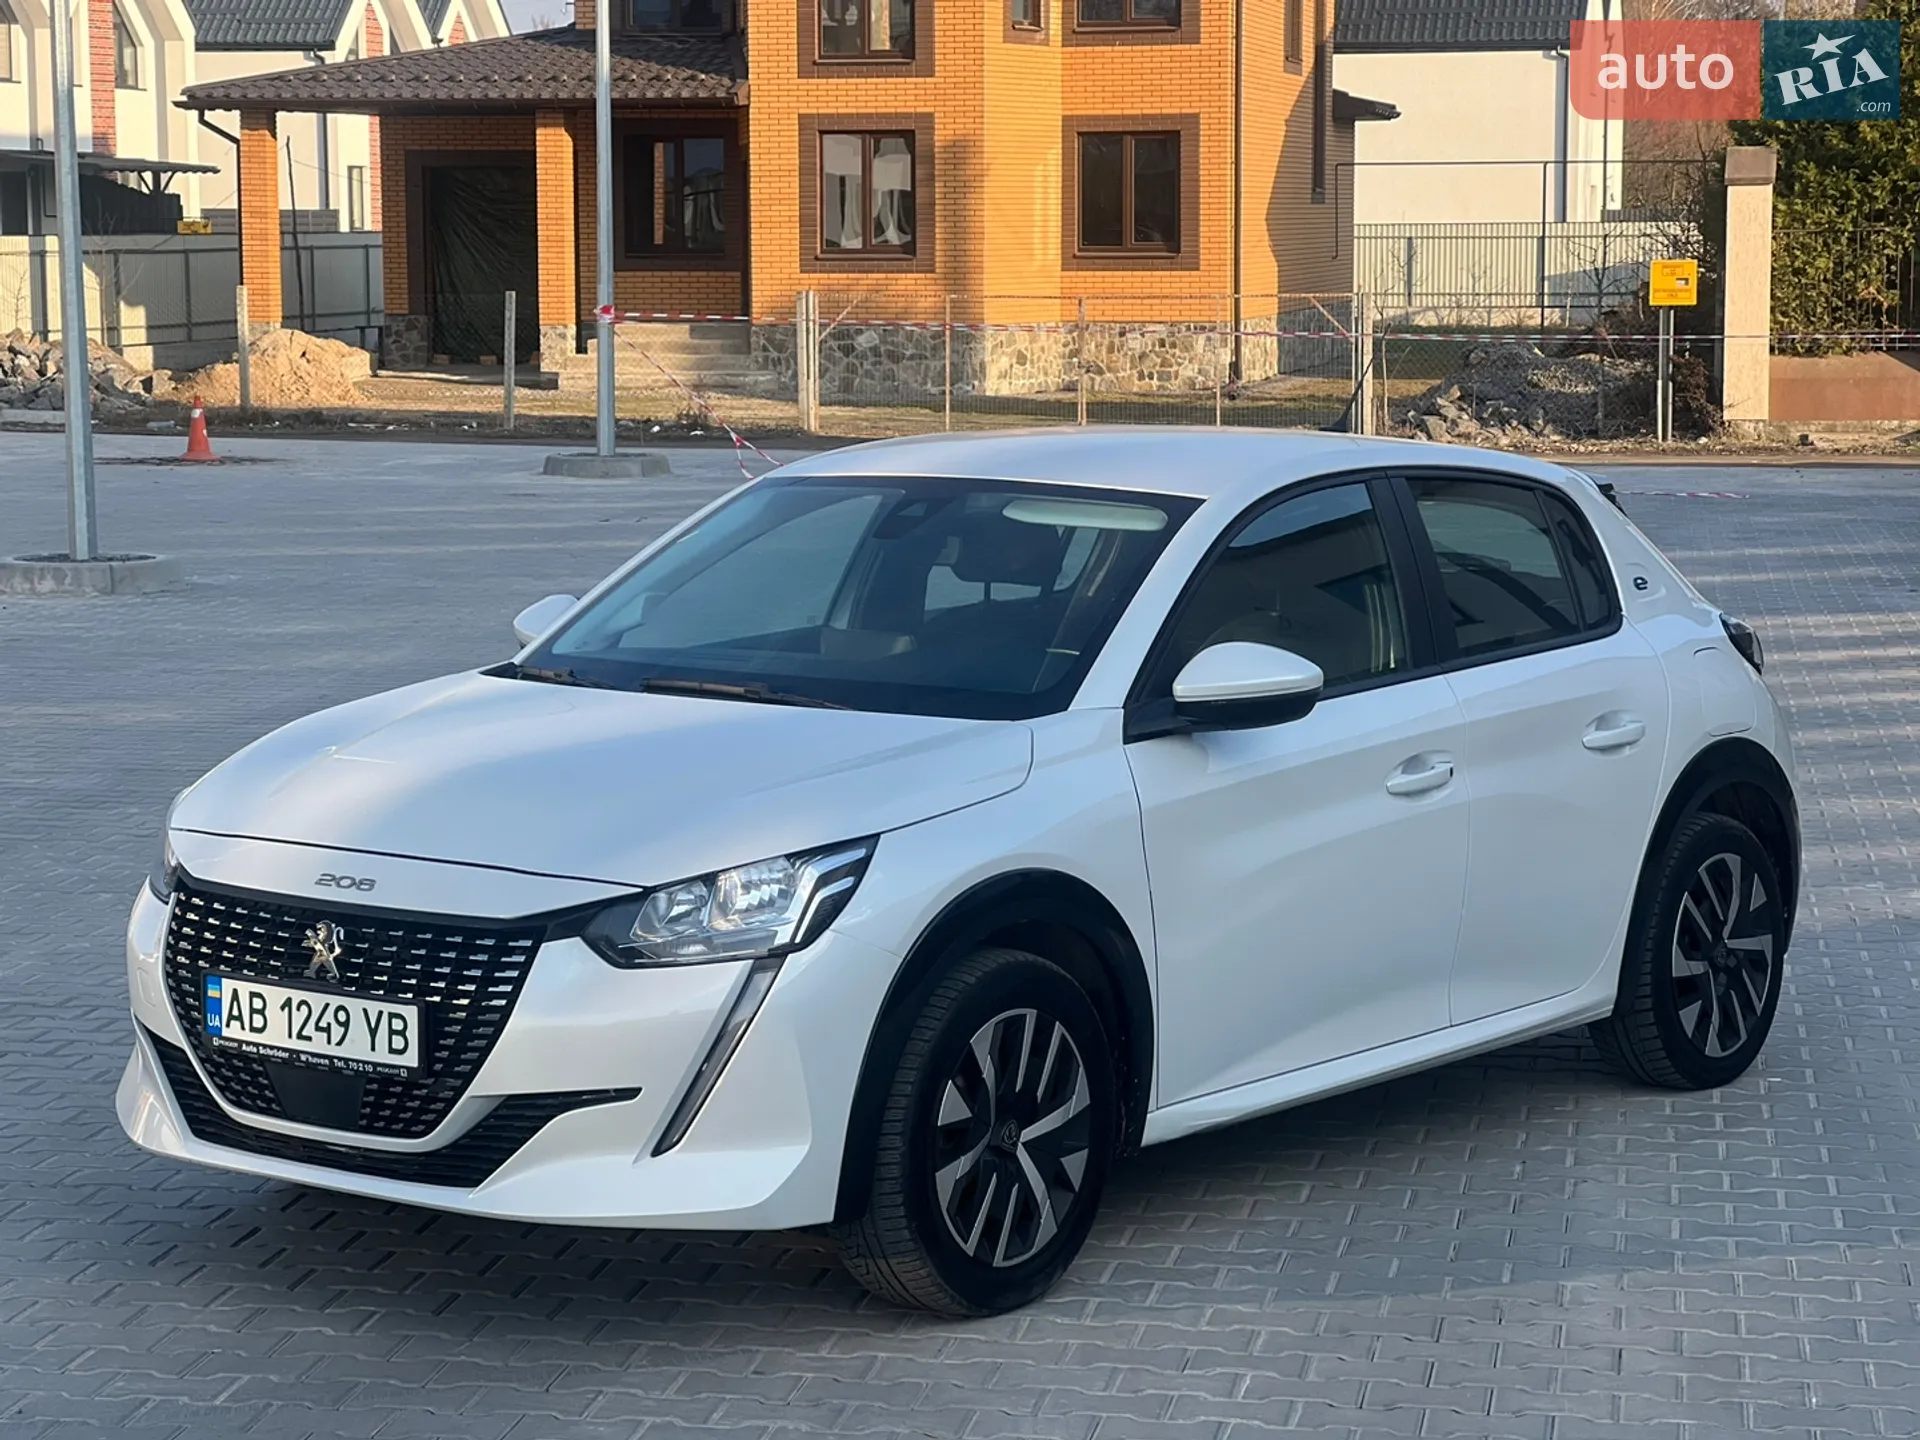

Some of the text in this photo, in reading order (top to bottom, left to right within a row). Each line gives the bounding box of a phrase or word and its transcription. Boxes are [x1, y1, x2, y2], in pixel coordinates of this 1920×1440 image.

[1633, 576, 1648, 591] e
[314, 873, 377, 892] 208
[207, 1014, 221, 1028] UA
[225, 988, 410, 1056] AB 1249 YB
